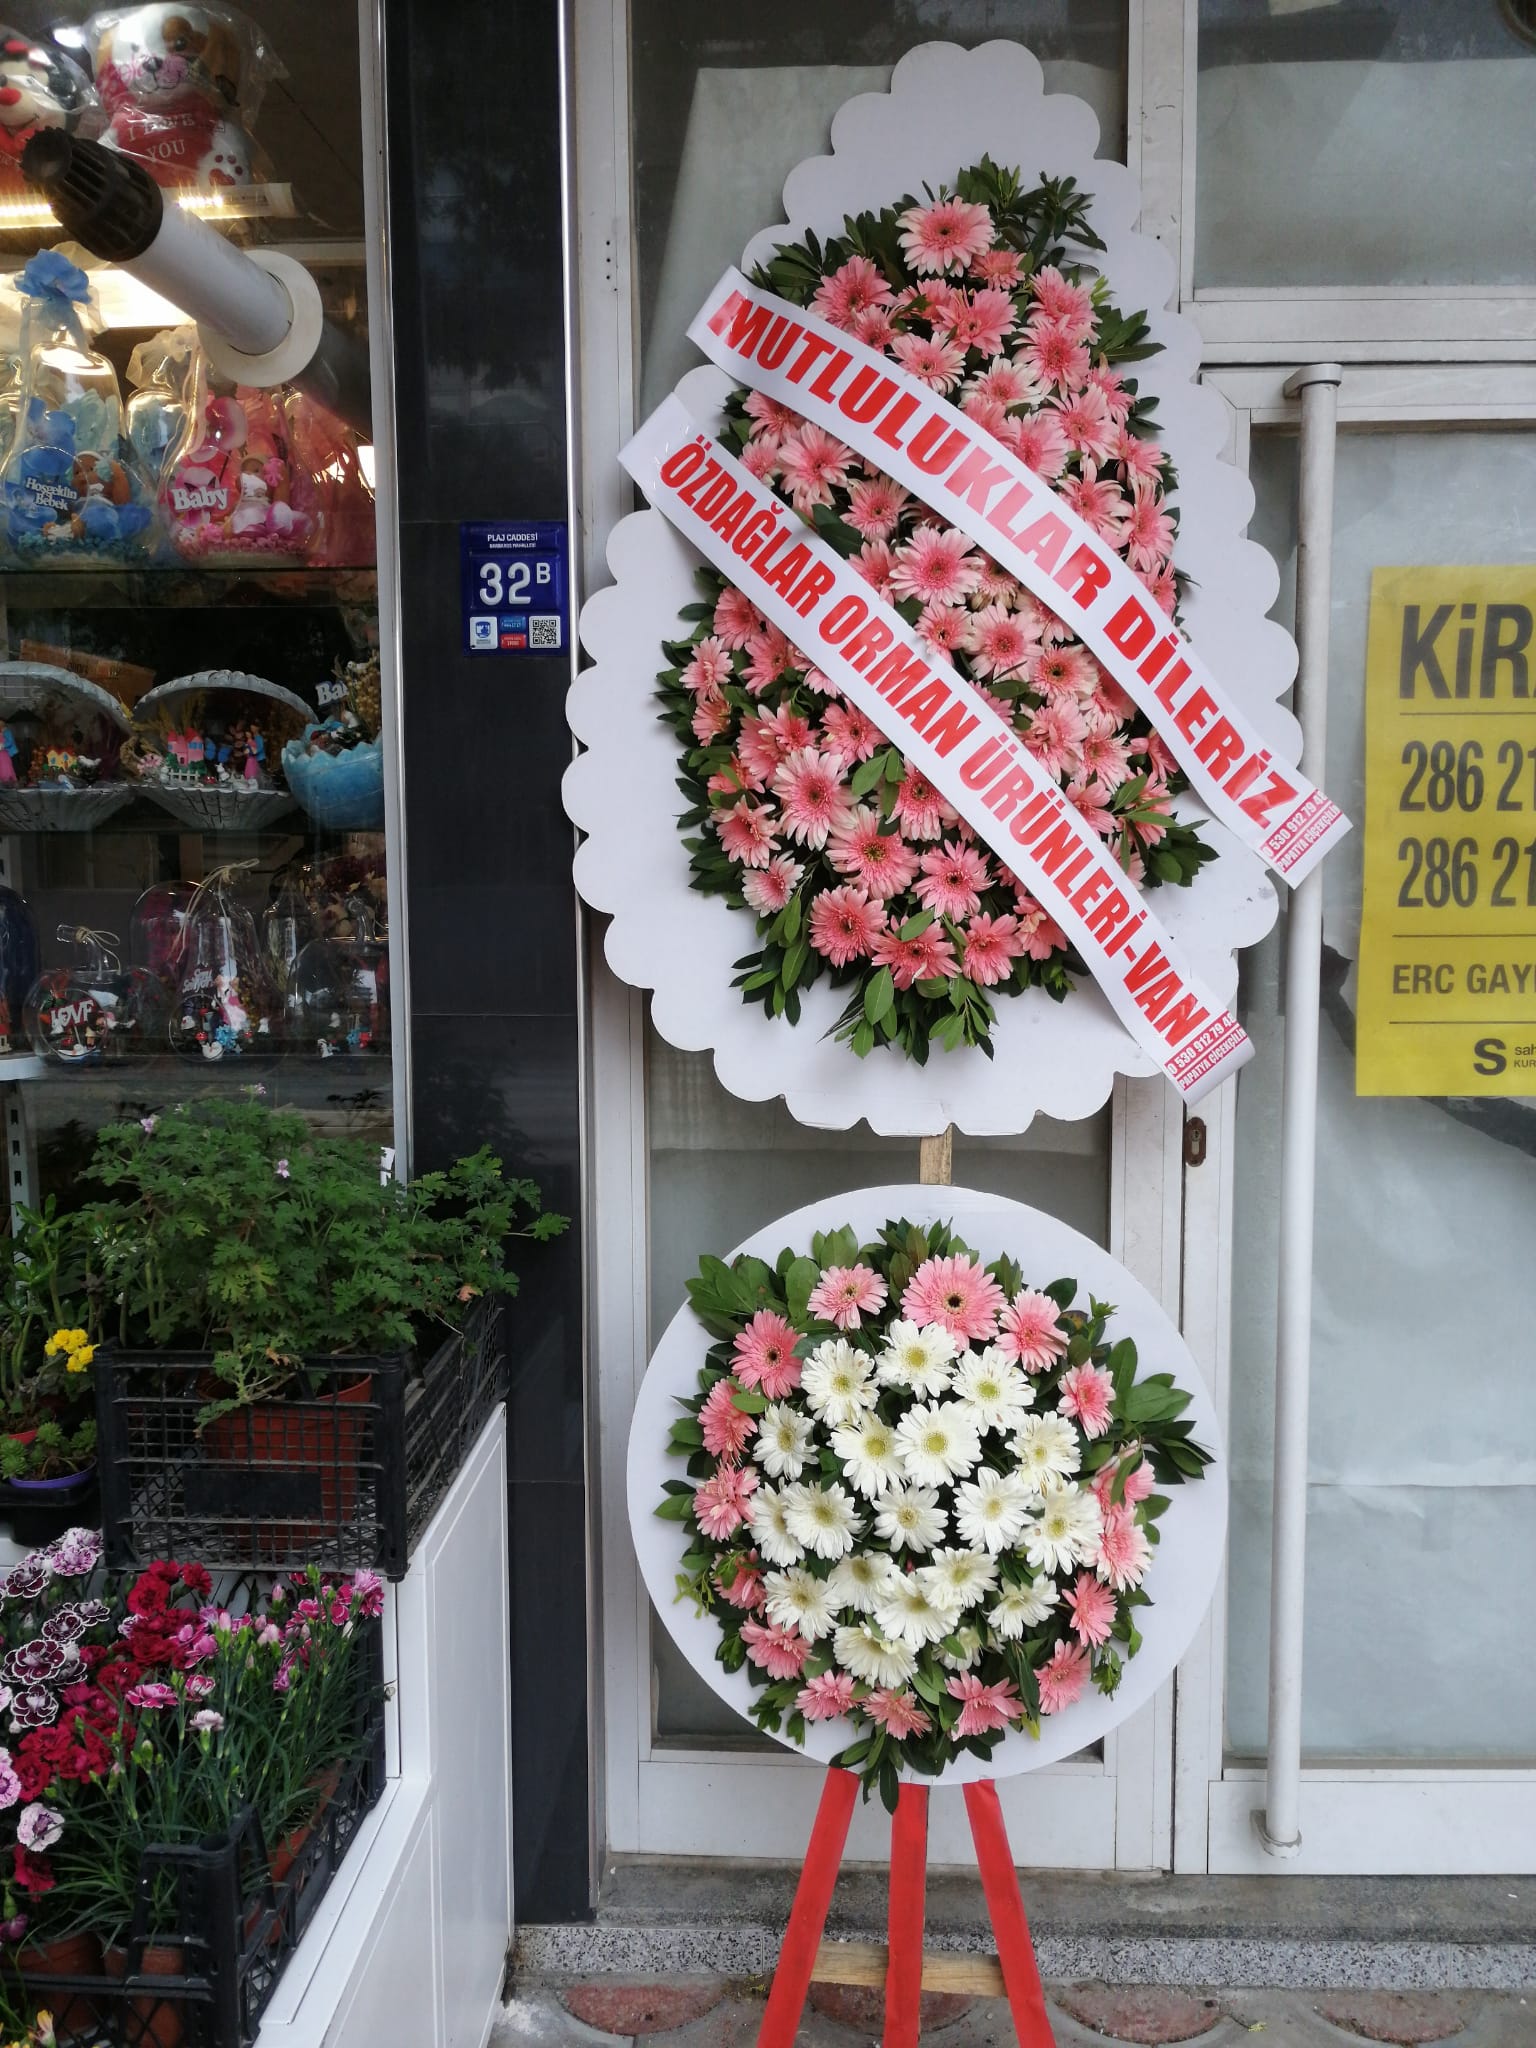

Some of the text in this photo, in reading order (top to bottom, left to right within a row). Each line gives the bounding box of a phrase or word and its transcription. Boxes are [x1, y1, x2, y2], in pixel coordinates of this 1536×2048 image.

[146, 139, 186, 161] YOU
[171, 486, 228, 510] Baby
[487, 531, 538, 542] PLAJ CADDESİ
[707, 289, 1299, 830] MUTLULUKLAR DİLERİZ
[479, 561, 532, 606] 32
[1400, 603, 1536, 700] KiR
[660, 434, 1211, 1048] ÖZDAĞLAR ORMAN ÜRÜNLERİ-VAN
[1399, 740, 1485, 813] 286
[1285, 811, 1307, 833] 912
[1276, 837, 1309, 872] PAPATYA
[1398, 836, 1479, 908] 286
[1393, 963, 1536, 995] ERC GAY
[1173, 1045, 1197, 1069] 530
[1192, 1031, 1214, 1053] 912
[1208, 1020, 1225, 1038] 79
[1473, 1038, 1507, 1076] S
[1178, 1056, 1211, 1088] PAPATYA
